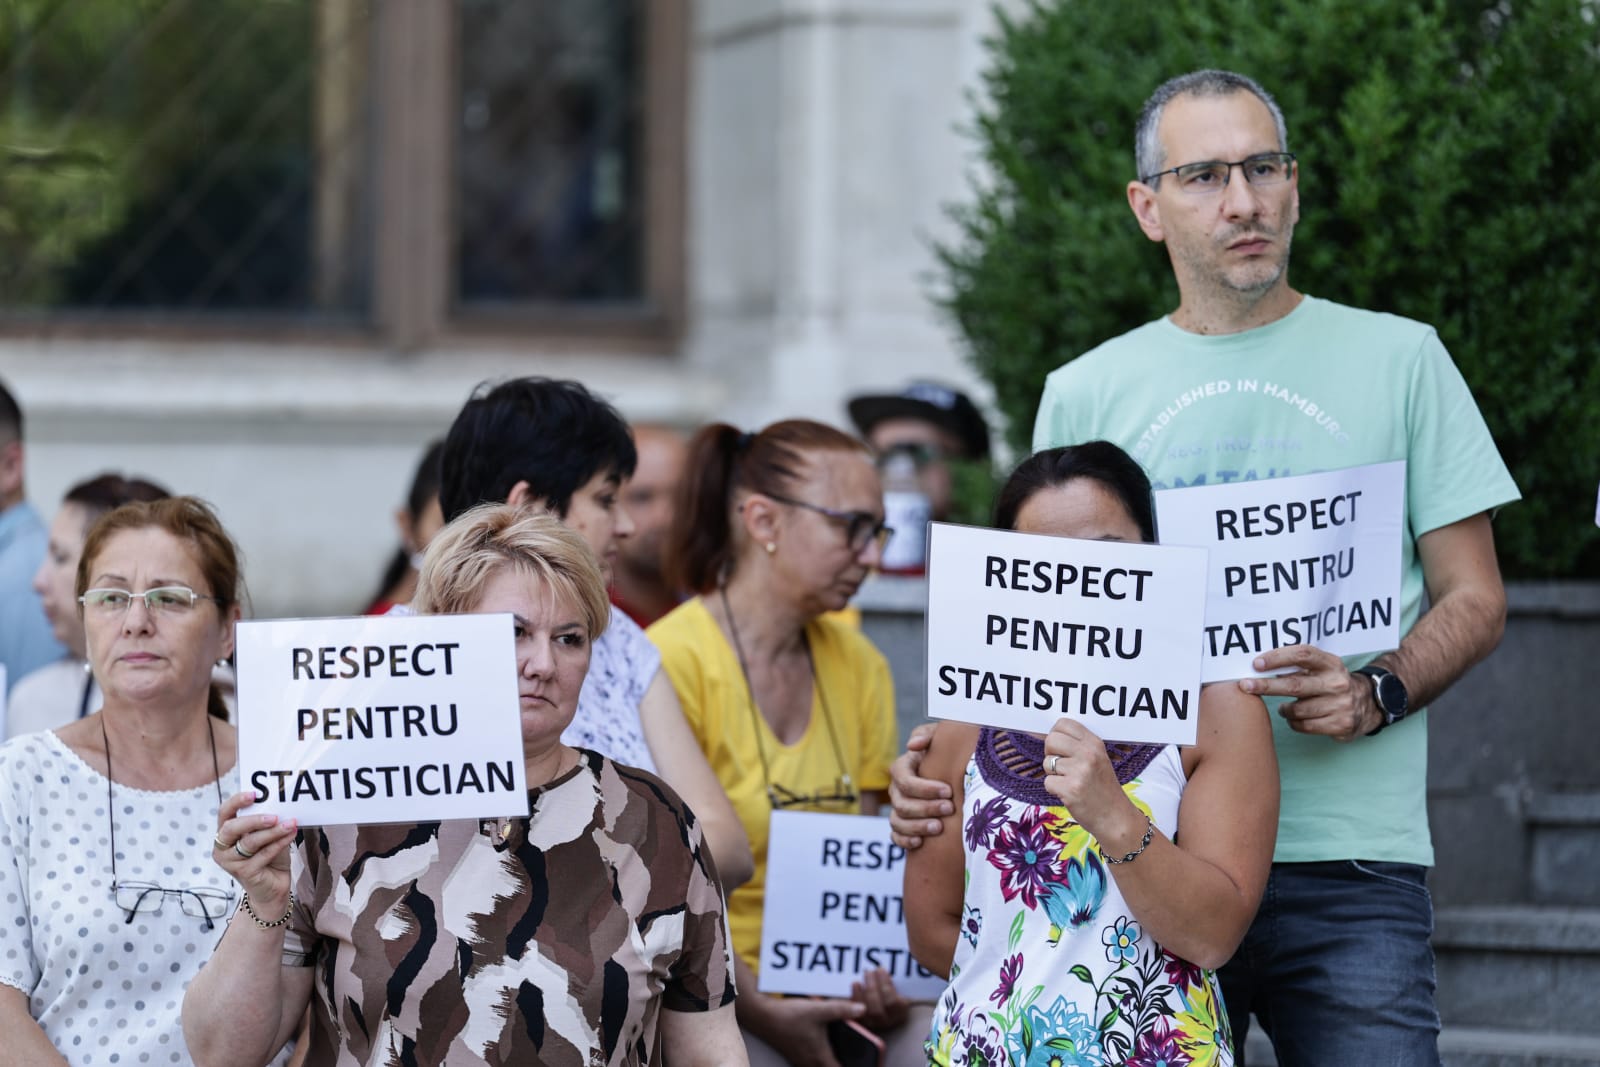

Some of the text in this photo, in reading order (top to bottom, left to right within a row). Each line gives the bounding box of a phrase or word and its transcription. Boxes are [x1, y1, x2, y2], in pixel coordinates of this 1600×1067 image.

[1237, 379, 1258, 393] IN
[1262, 381, 1350, 446] HAMBURG
[1216, 491, 1363, 541] RESPECT
[985, 555, 1153, 602] RESPECT
[1224, 547, 1355, 598] PENTRU
[986, 614, 1143, 661] PENTRU
[1203, 597, 1393, 658] TATISTICIAN
[292, 643, 460, 681] RESPECT
[938, 665, 1189, 720] STATISTICIAN
[297, 704, 458, 741] PENTRU
[251, 761, 515, 803] STATISTICIAN
[821, 839, 906, 871] RESP
[819, 891, 904, 924] PENT
[771, 941, 932, 978] STATISTI
